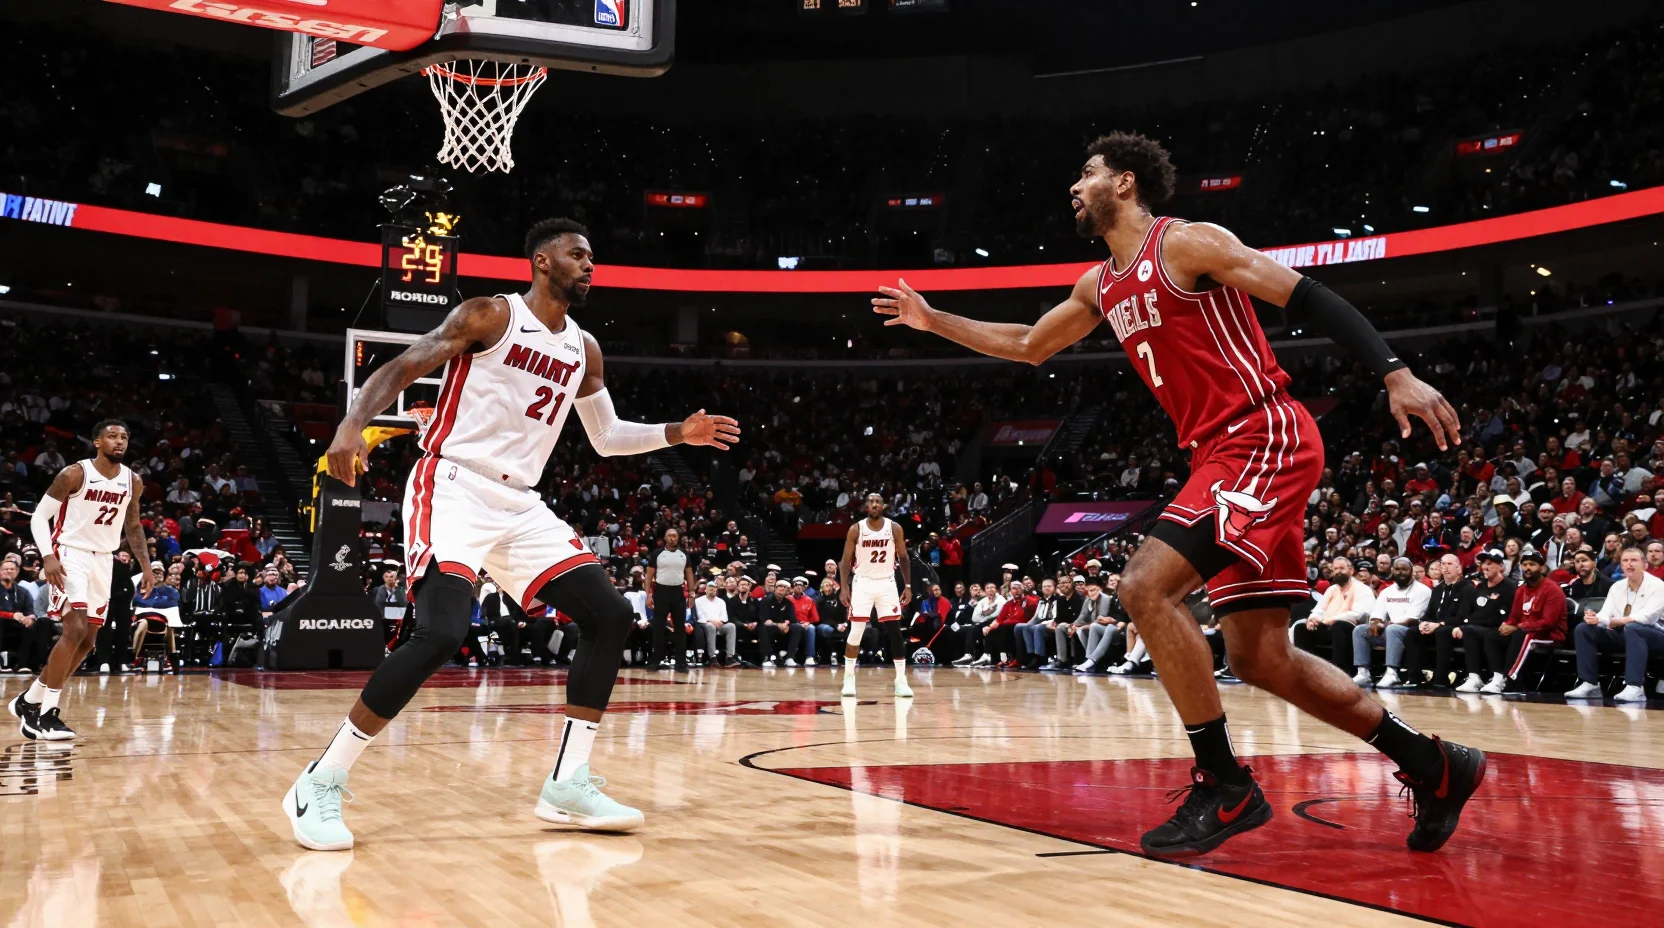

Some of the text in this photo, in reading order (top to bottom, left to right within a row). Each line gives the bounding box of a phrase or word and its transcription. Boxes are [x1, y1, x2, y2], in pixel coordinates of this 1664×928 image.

[525, 385, 566, 427] 21
[94, 505, 119, 526] 22
[869, 550, 887, 563] 22
